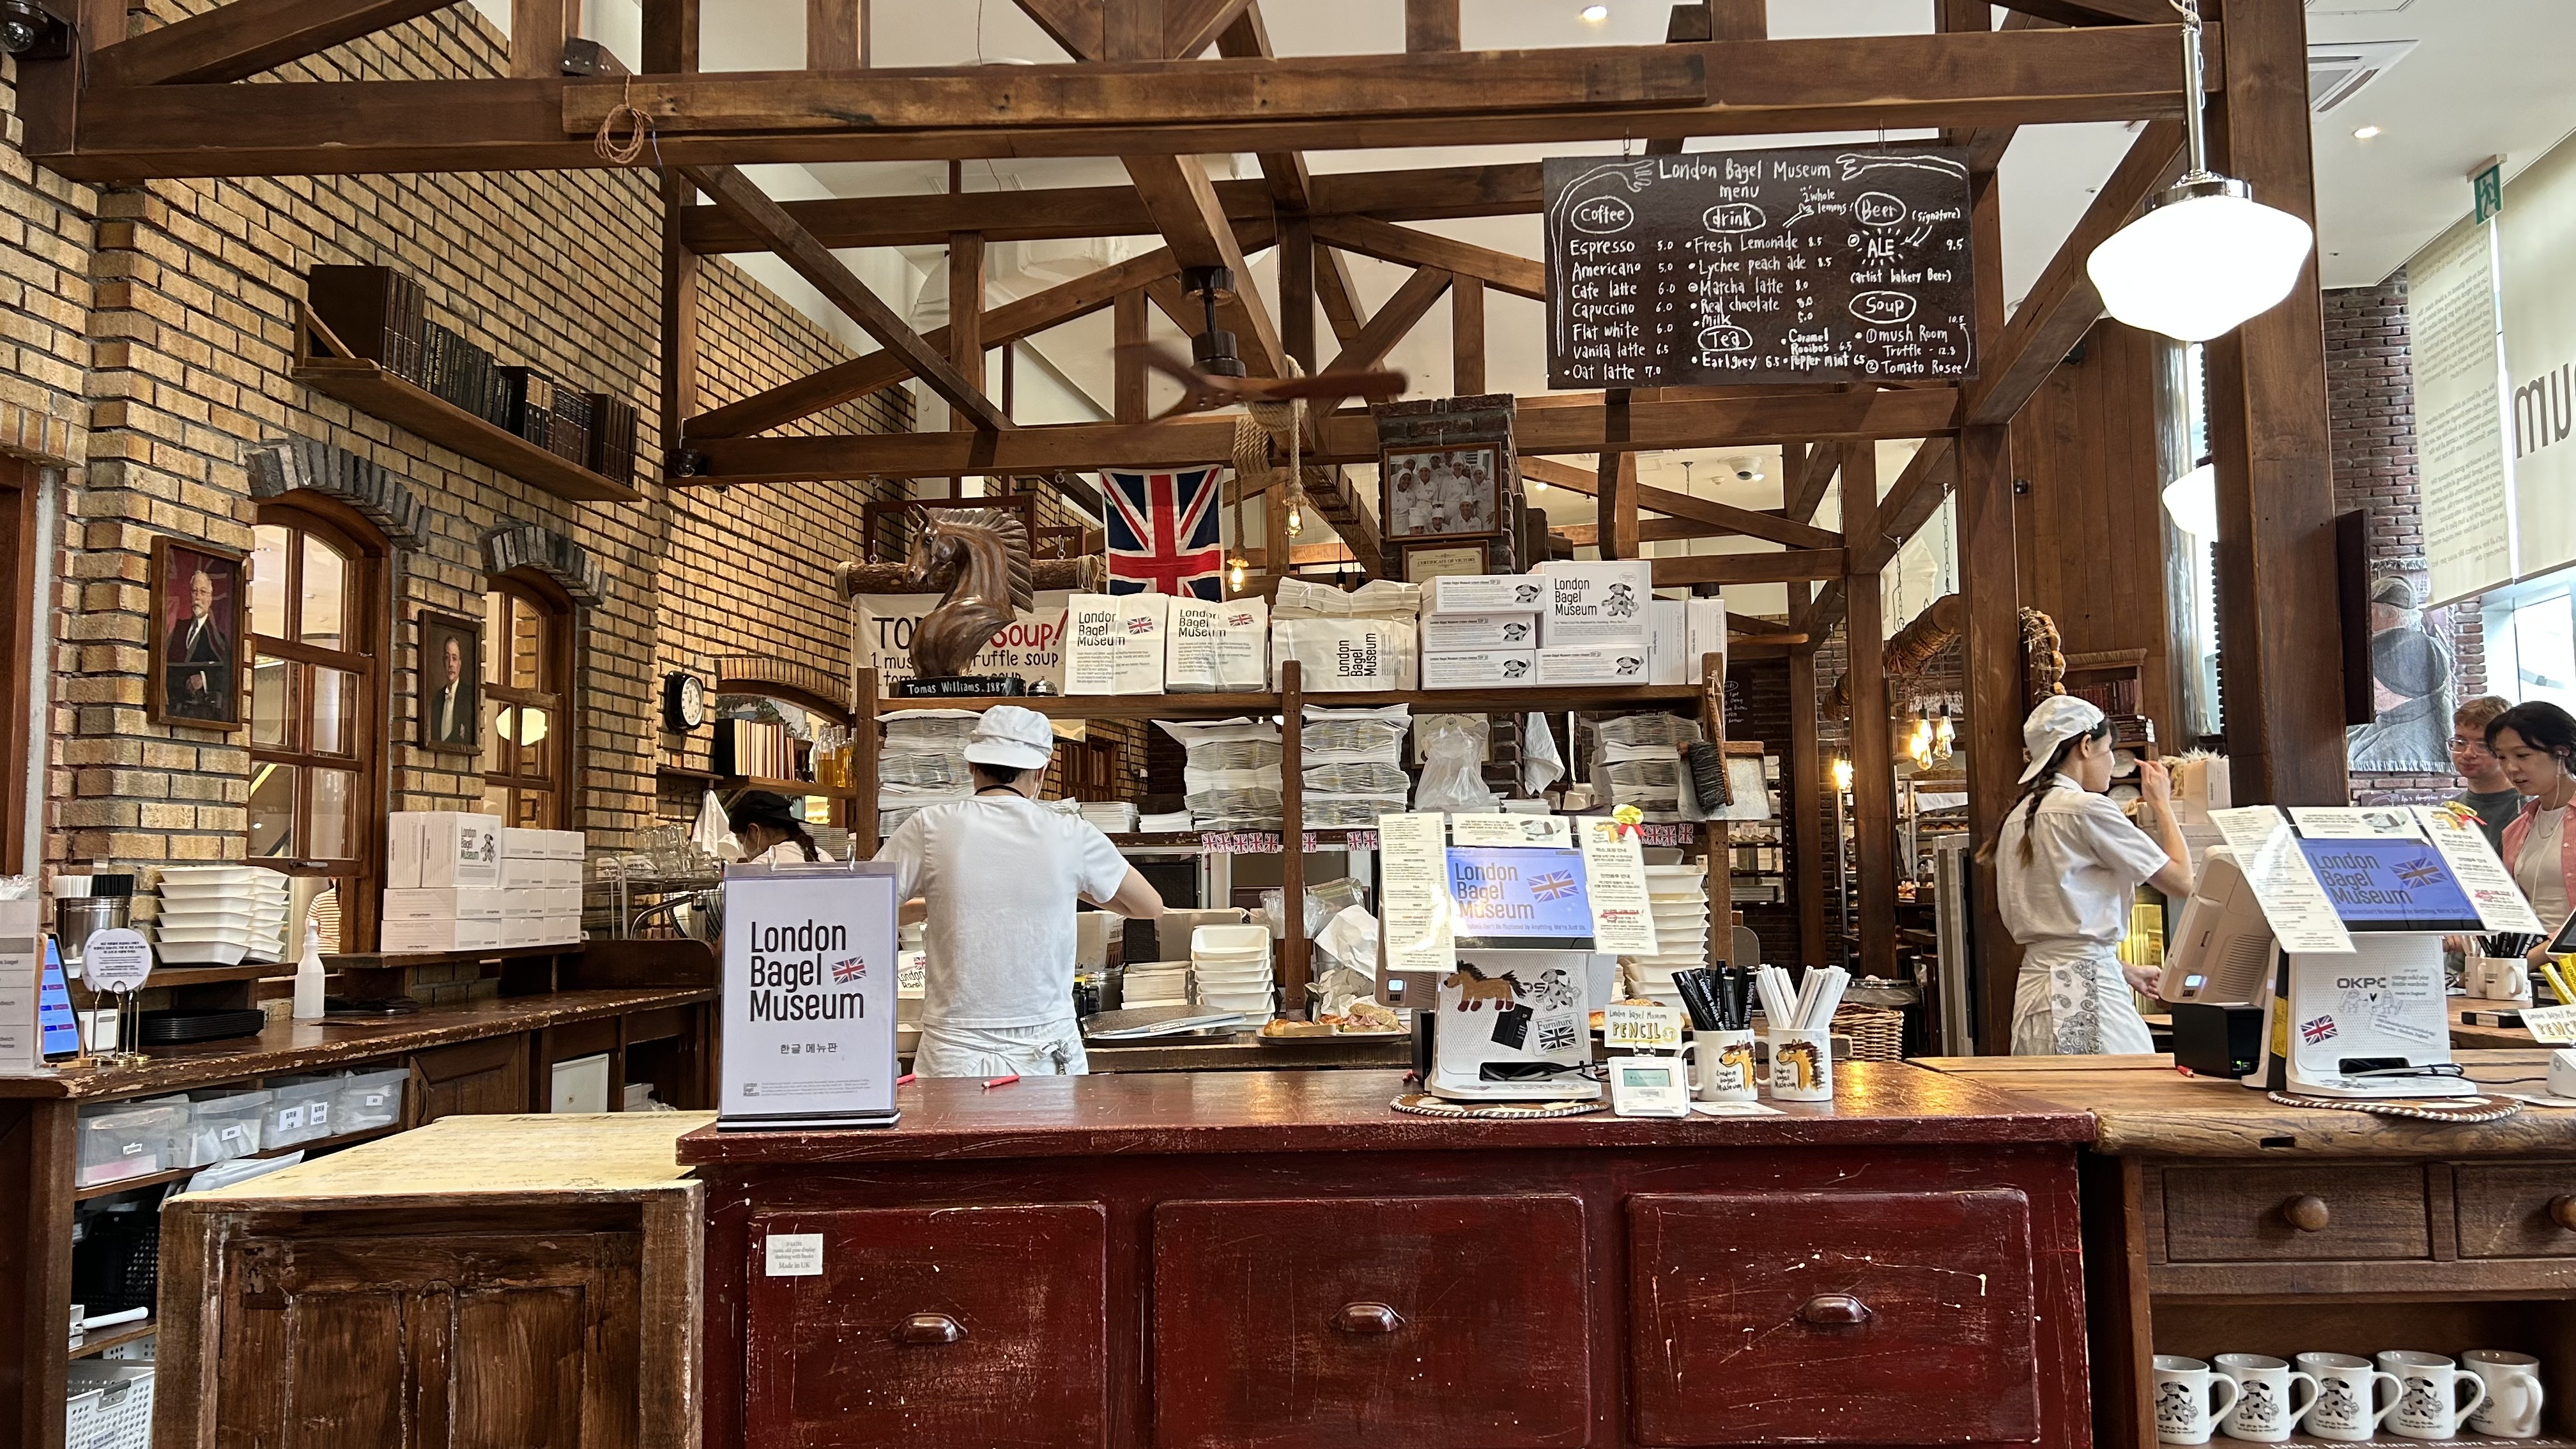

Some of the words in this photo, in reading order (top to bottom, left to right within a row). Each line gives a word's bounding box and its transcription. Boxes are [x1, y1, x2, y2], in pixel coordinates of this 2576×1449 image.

[1659, 156, 1717, 181] London
[1726, 158, 1761, 185] Bagel
[1774, 161, 1831, 181] Museum
[1719, 184, 1759, 201] menu
[1712, 206, 1751, 228] drink
[1862, 199, 1898, 223] Beer
[1570, 240, 1636, 261] Espresso
[1657, 240, 1674, 252] 5.0
[1693, 236, 1732, 254] Fresh
[1740, 231, 1798, 252] Lemonade
[1808, 236, 1823, 247] 8.5
[1867, 237, 1894, 258] ALE
[1946, 238, 1963, 250] 9.5
[1572, 261, 1641, 282] Americano
[1699, 259, 1740, 280] Lychee
[1748, 256, 1780, 275] peach
[1787, 255, 1807, 271] ade
[1818, 257, 1832, 269] 8.5
[1850, 270, 1882, 284] (artist
[1890, 270, 1921, 284] bakery
[1927, 267, 1951, 283] Beer)
[1572, 282, 1598, 300] Cafe
[1609, 280, 1637, 298] latte
[1658, 282, 1676, 295] 6.0
[1700, 277, 1745, 298] Matcha
[1755, 277, 1784, 295] latte
[1795, 279, 1809, 291] 8.0
[1572, 303, 1635, 322] Capuccino
[1655, 302, 1673, 313] 6.0
[1701, 296, 1724, 314] Real
[1729, 295, 1780, 312] chocolate
[1796, 296, 1813, 309] 8.0
[1865, 296, 1905, 317] Soup
[1797, 311, 1813, 323] 5.0
[1948, 315, 1965, 324] 10.5
[1572, 323, 1598, 341] Flat
[1604, 321, 1639, 339] white
[1656, 323, 1673, 335] 6.0
[1706, 331, 1740, 348] Tea
[1788, 327, 1829, 342] Caramel
[1919, 325, 1948, 343] Room
[1617, 342, 1646, 358] latte
[1656, 343, 1669, 355] 6.5
[1791, 342, 1829, 355] Rooibos
[1839, 341, 1852, 351] 6.5
[1882, 345, 1922, 357] Truffle
[1765, 356, 1780, 368] 6.5
[1881, 360, 1924, 375] Tomato
[1931, 360, 1962, 375] Rosee
[1572, 364, 1595, 379] Oat
[1604, 363, 1635, 380] latte
[1645, 366, 1661, 378] 7.0
[1554, 578, 1590, 590] London
[1555, 590, 1581, 605] Bagel
[1555, 604, 1597, 615] Museum
[1078, 623, 1108, 638] Bagel
[1077, 636, 1125, 647] Museum
[973, 650, 1018, 666] ruffle
[1337, 640, 1349, 677] London
[1350, 649, 1366, 677] Bagel
[1364, 633, 1376, 676] Museum
[907, 684, 937, 695] Tomas
[2310, 852, 2380, 870] London
[1455, 862, 1519, 882] London
[2319, 870, 2375, 891] Bagel
[1457, 881, 1505, 903] Bagel
[2328, 887, 2413, 905] Museum
[1459, 900, 1535, 919] Museum
[751, 919, 847, 953] London
[750, 953, 822, 992] Bagel
[1699, 978, 1713, 1002] LONDON
[750, 990, 864, 1022] Museum
[1537, 1018, 1573, 1031] Furniture
[1613, 1022, 1661, 1039] PENCIL
[780, 1044, 801, 1054] 한글
[806, 1043, 838, 1053] 메뉴판
